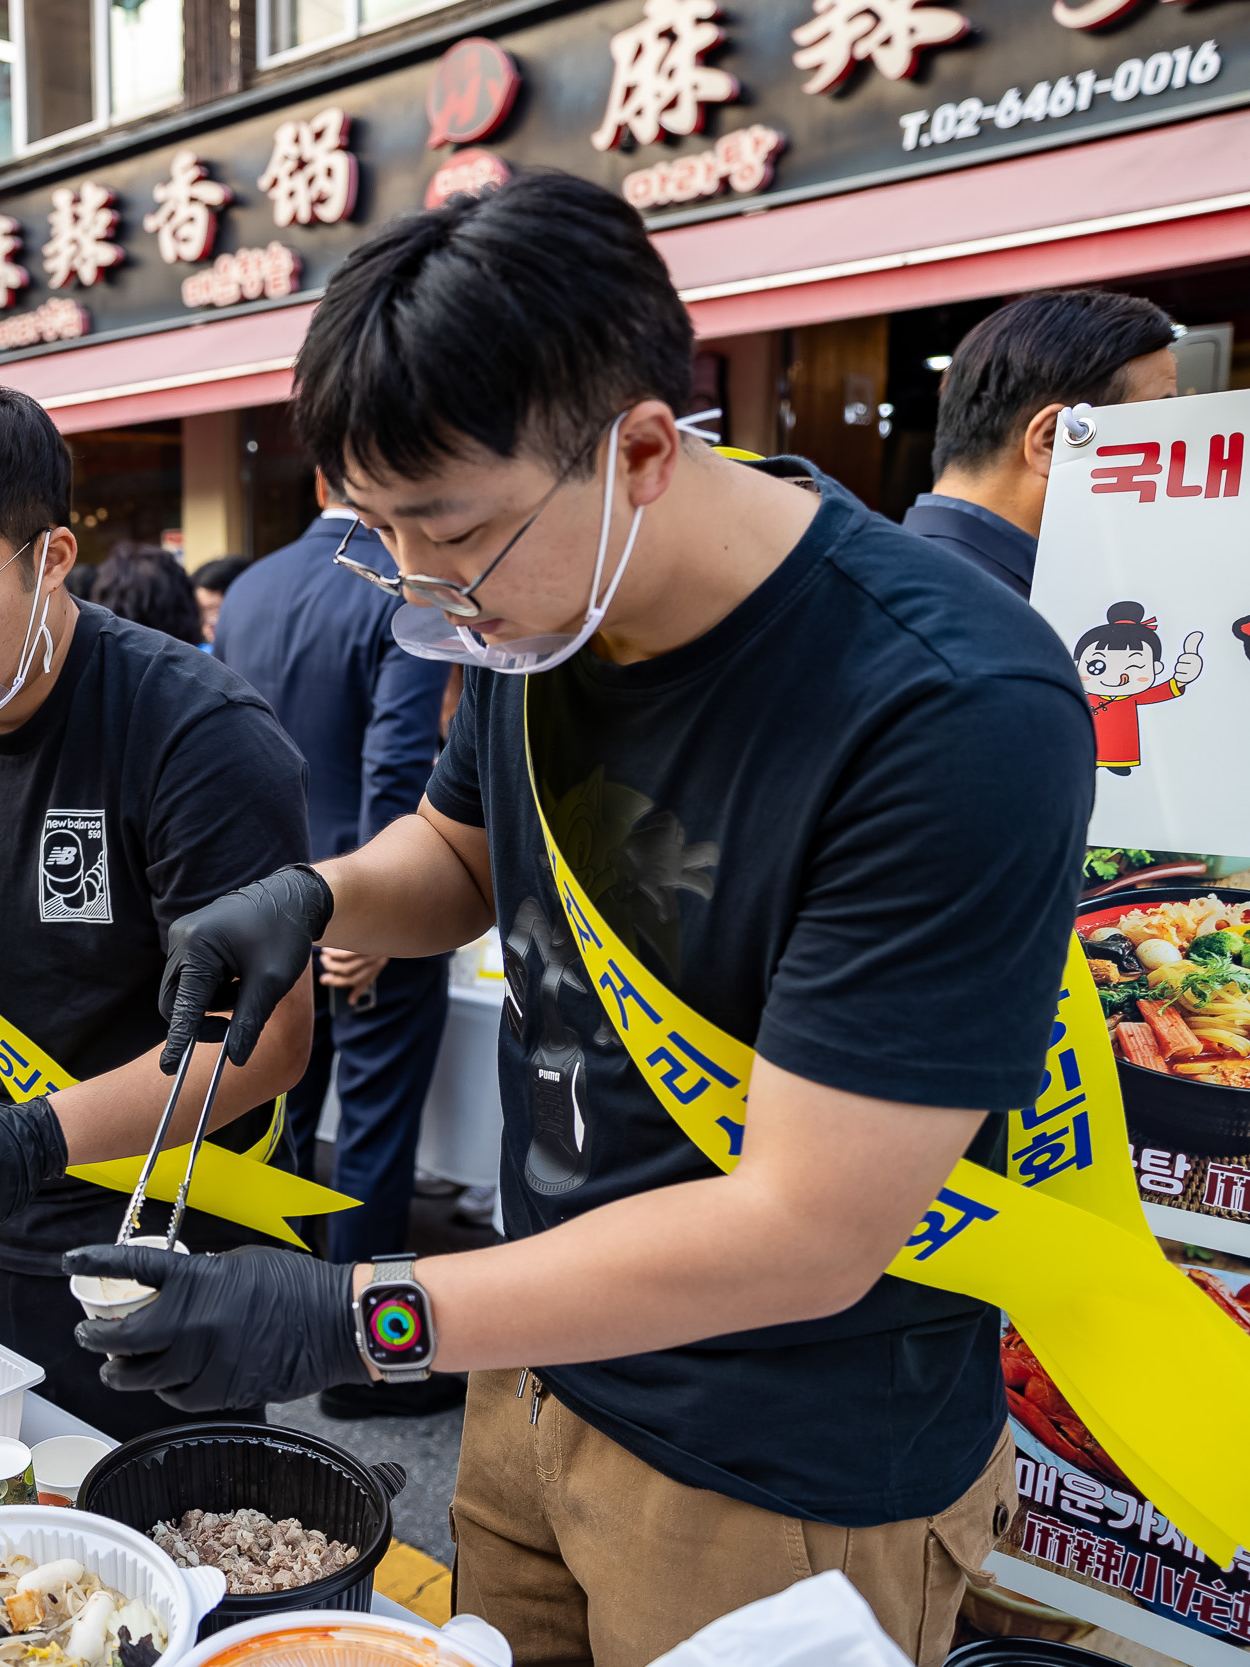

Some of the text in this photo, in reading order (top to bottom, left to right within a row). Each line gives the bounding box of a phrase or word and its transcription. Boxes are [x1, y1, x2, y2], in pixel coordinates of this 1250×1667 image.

[898, 38, 1222, 152] T.02-6461-0016
[623, 124, 784, 209] 마라탕
[1090, 432, 1244, 504] 국내
[47, 817, 101, 830] new balance
[538, 1068, 561, 1083] PUMA
[1128, 1143, 1192, 1195] 탕
